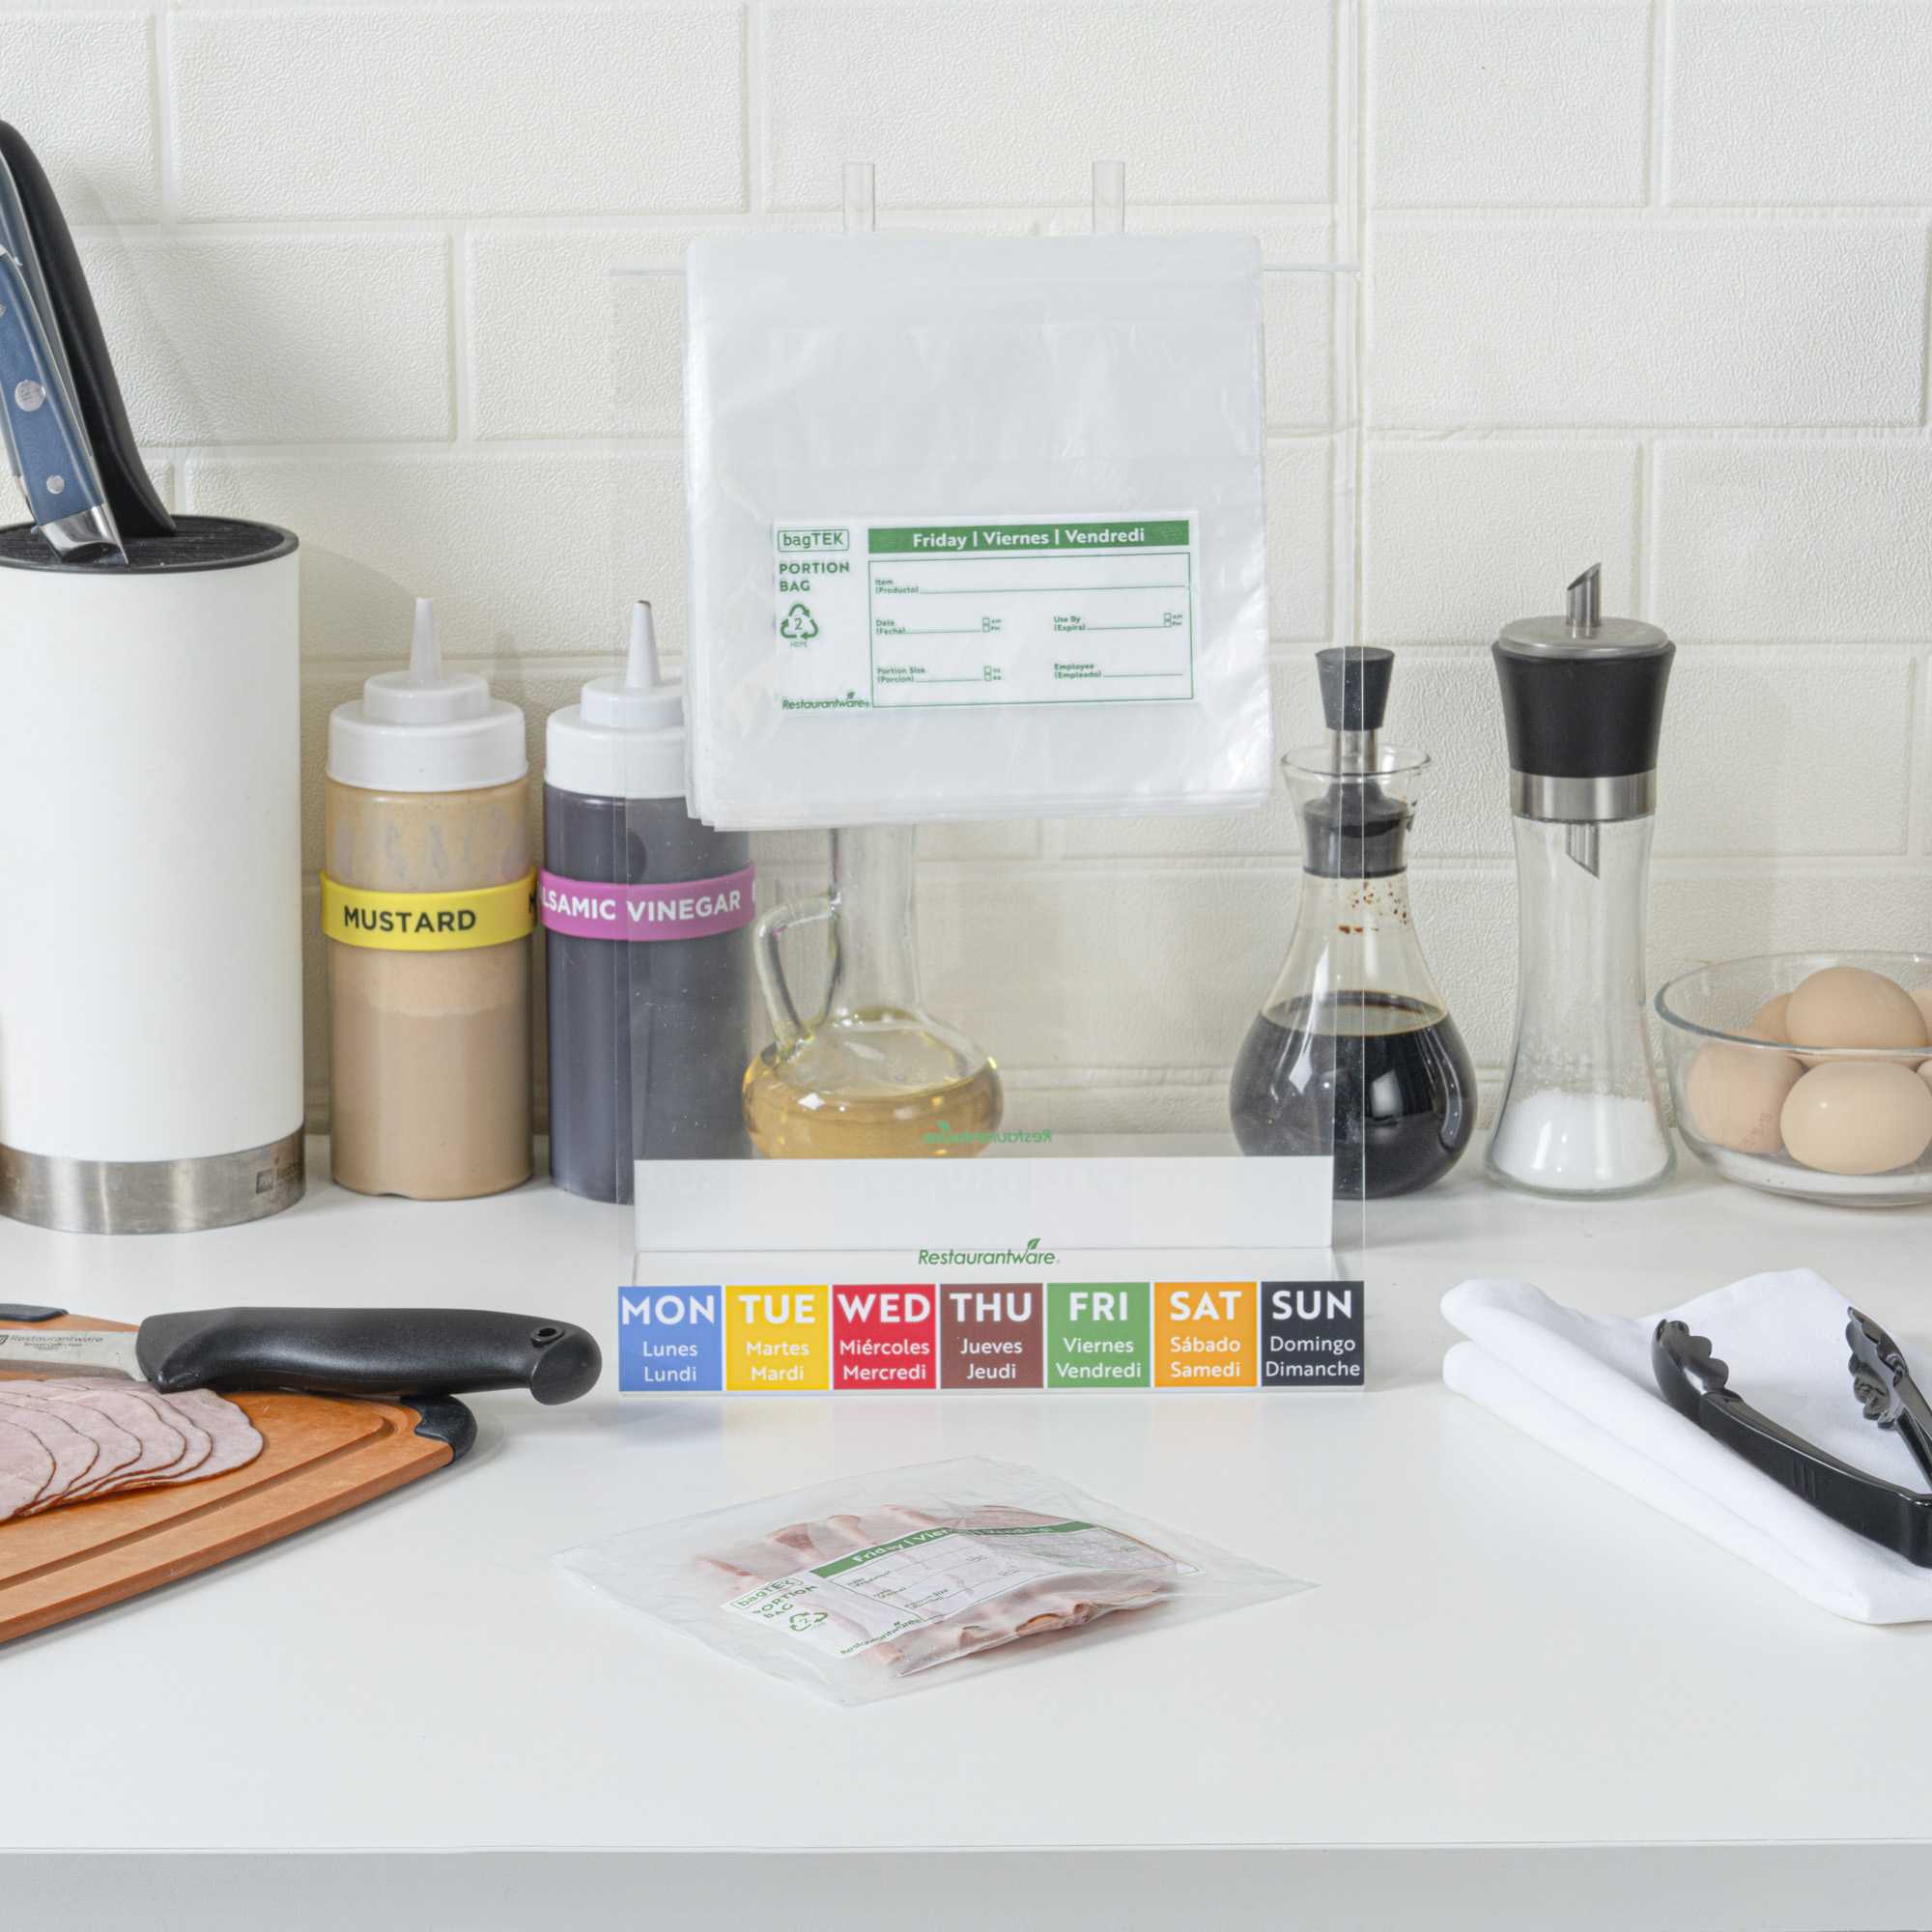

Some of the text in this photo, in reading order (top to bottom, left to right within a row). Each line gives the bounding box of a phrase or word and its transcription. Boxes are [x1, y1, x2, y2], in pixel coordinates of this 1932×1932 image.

[782, 532, 843, 549] bagTEK
[913, 528, 1145, 550] Friday Viernes Vendredi
[780, 562, 849, 574] PORTION
[780, 580, 810, 592] BAG
[794, 617, 803, 630] 2
[1070, 614, 1081, 624] By
[877, 666, 925, 675] Portion Size
[1054, 663, 1094, 671] Employee
[781, 696, 867, 710] Restaurantware
[539, 882, 616, 921] LSAMIC
[626, 890, 741, 922] VINEGAR
[343, 905, 477, 933] MUSTARD
[919, 1244, 1057, 1265] Restaurantware
[622, 1294, 715, 1325] MON
[738, 1294, 815, 1324] TUE
[837, 1293, 930, 1323] WED
[950, 1292, 1033, 1322] THU
[1069, 1292, 1128, 1321] FRI
[1170, 1291, 1242, 1321] SAT
[1271, 1290, 1352, 1320] SUN
[642, 1341, 697, 1357] Lunes
[746, 1340, 810, 1356] Martes
[839, 1338, 930, 1356] Miércoles
[960, 1338, 1023, 1354] Jueves
[1063, 1337, 1134, 1353] Viernes
[1170, 1336, 1241, 1352] Sábado
[1270, 1336, 1356, 1355] Domingo
[644, 1366, 696, 1382] Lundi
[751, 1365, 805, 1380] Mardi
[843, 1364, 926, 1380] Mercredi
[966, 1363, 1016, 1379] Jeudi
[1056, 1362, 1141, 1378] Vendredi
[1170, 1360, 1240, 1378] Samedi
[1265, 1359, 1361, 1378] Dimanche
